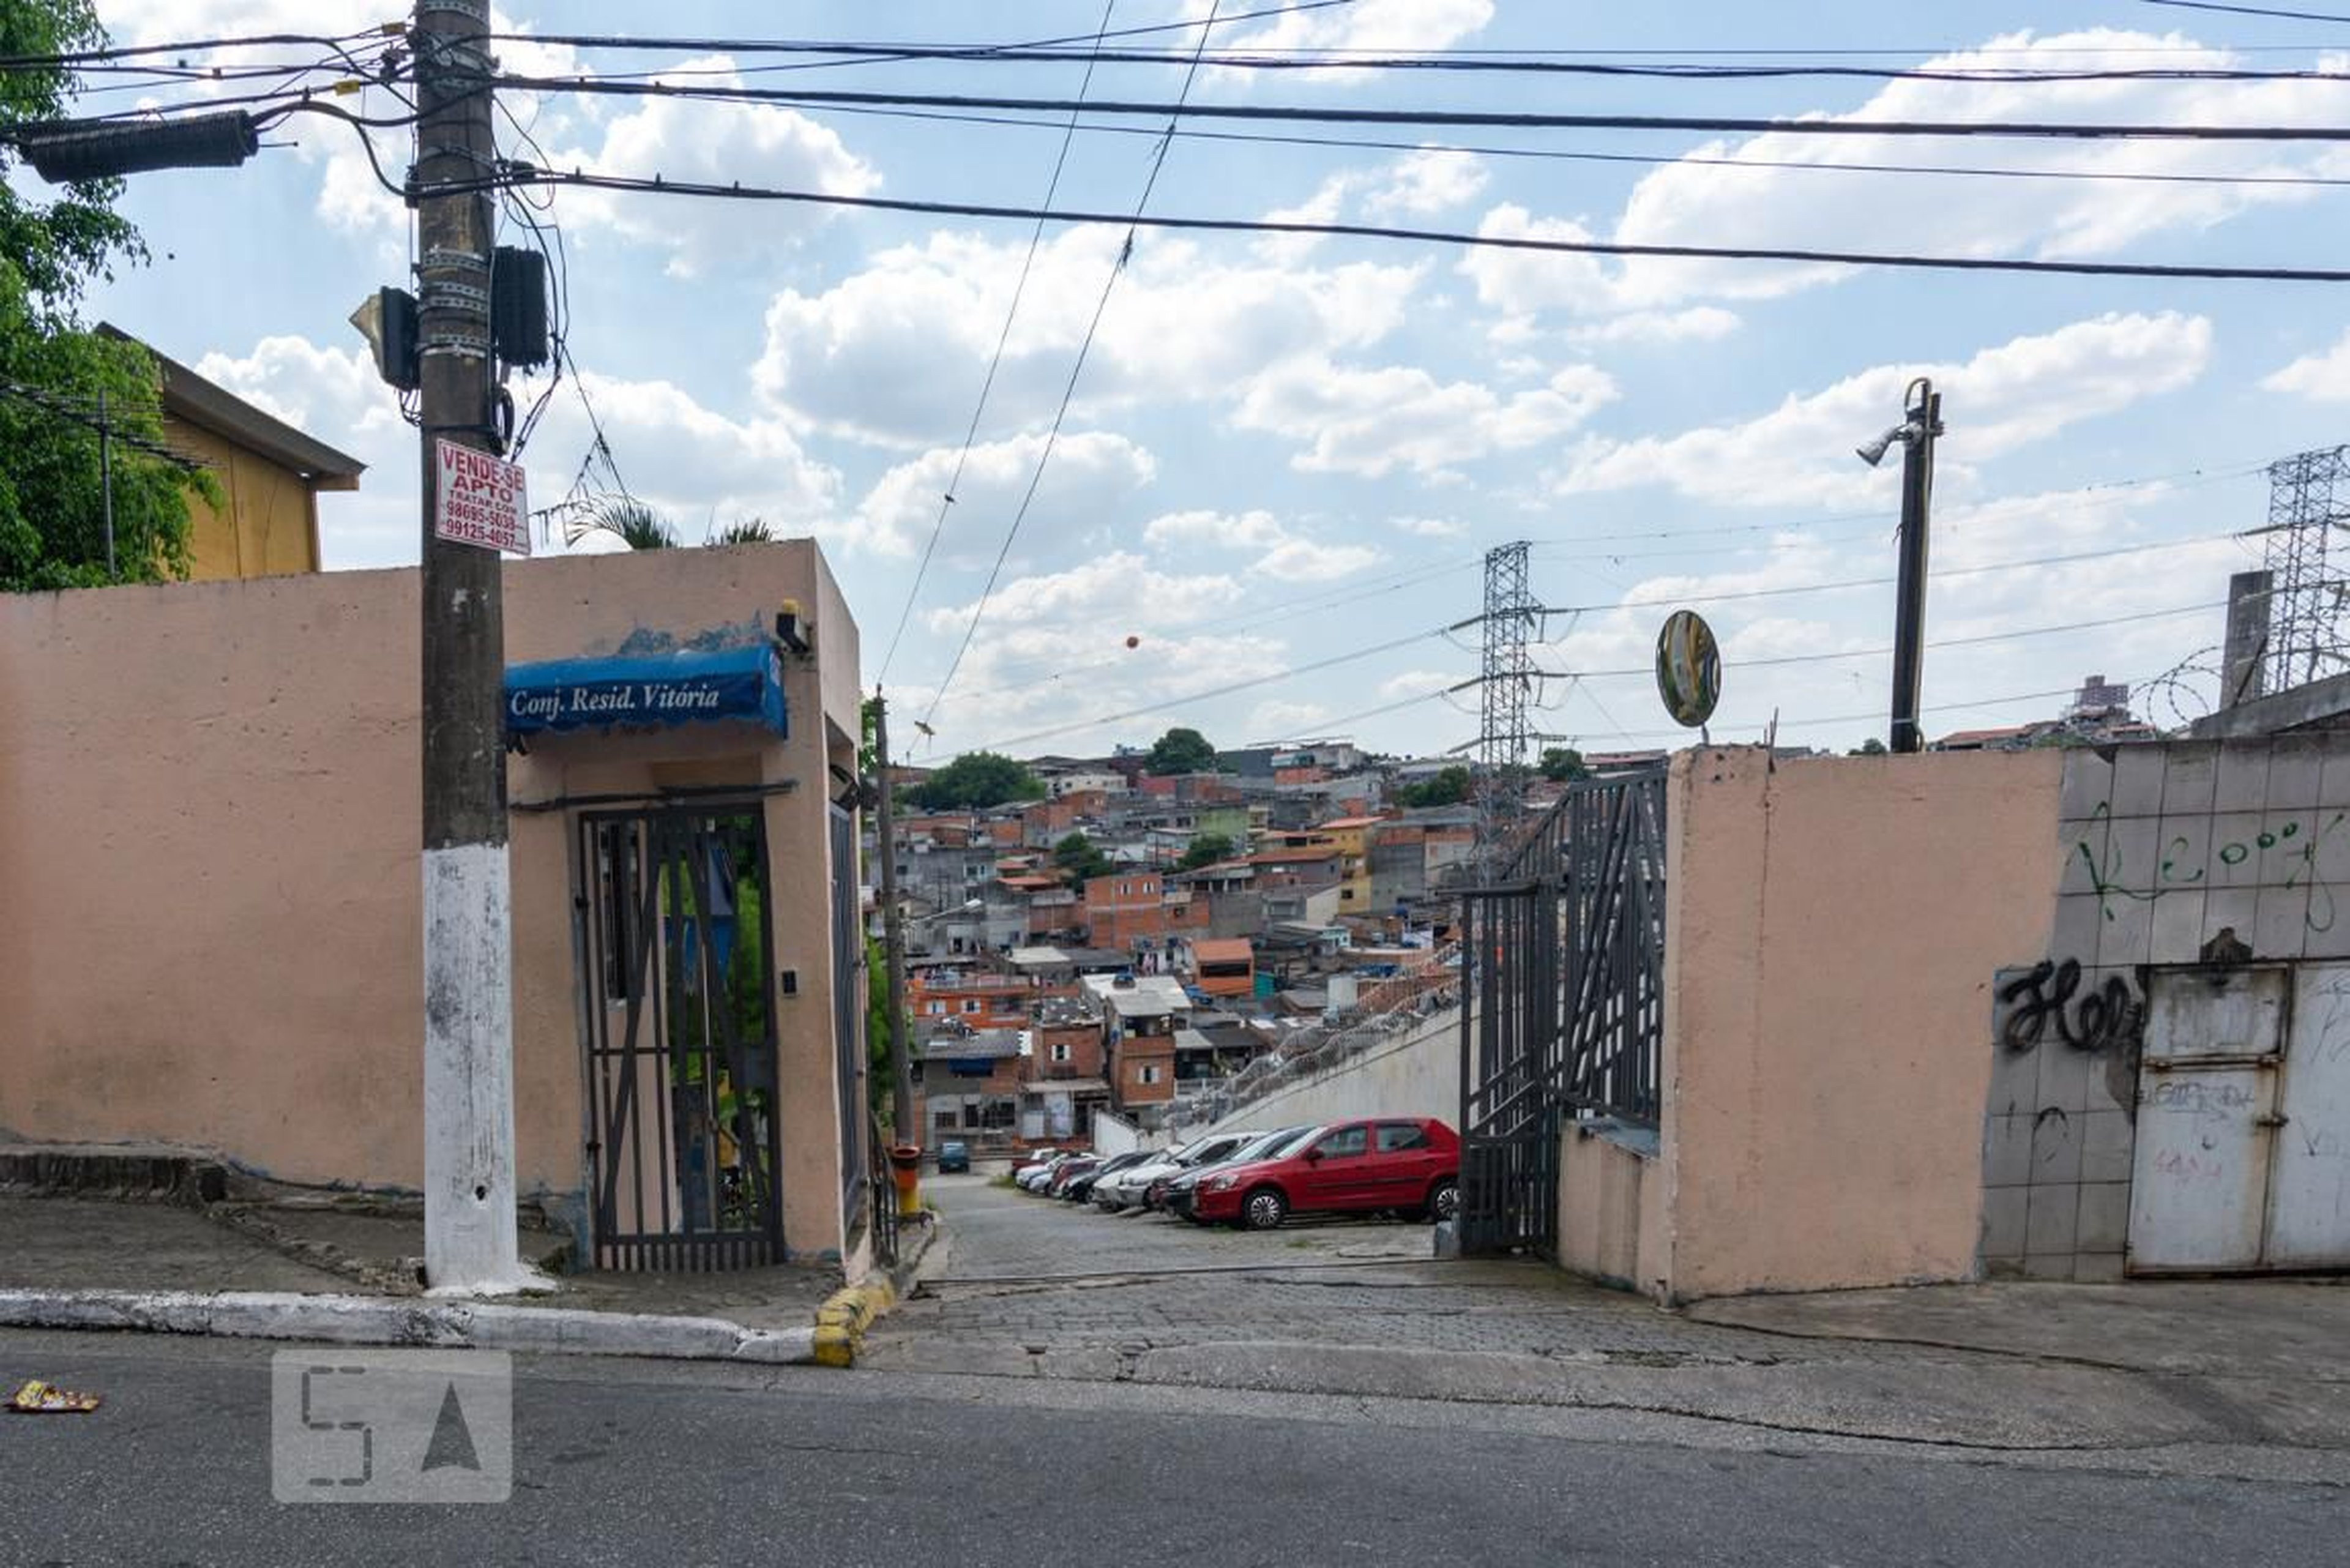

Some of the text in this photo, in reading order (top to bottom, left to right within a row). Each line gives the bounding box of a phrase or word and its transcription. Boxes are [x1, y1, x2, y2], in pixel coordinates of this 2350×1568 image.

[442, 446, 523, 491] VENDE-SE
[450, 490, 493, 508] TRATAR
[453, 473, 512, 503] APTO
[511, 683, 720, 720] Conj. Resid. Vitória
